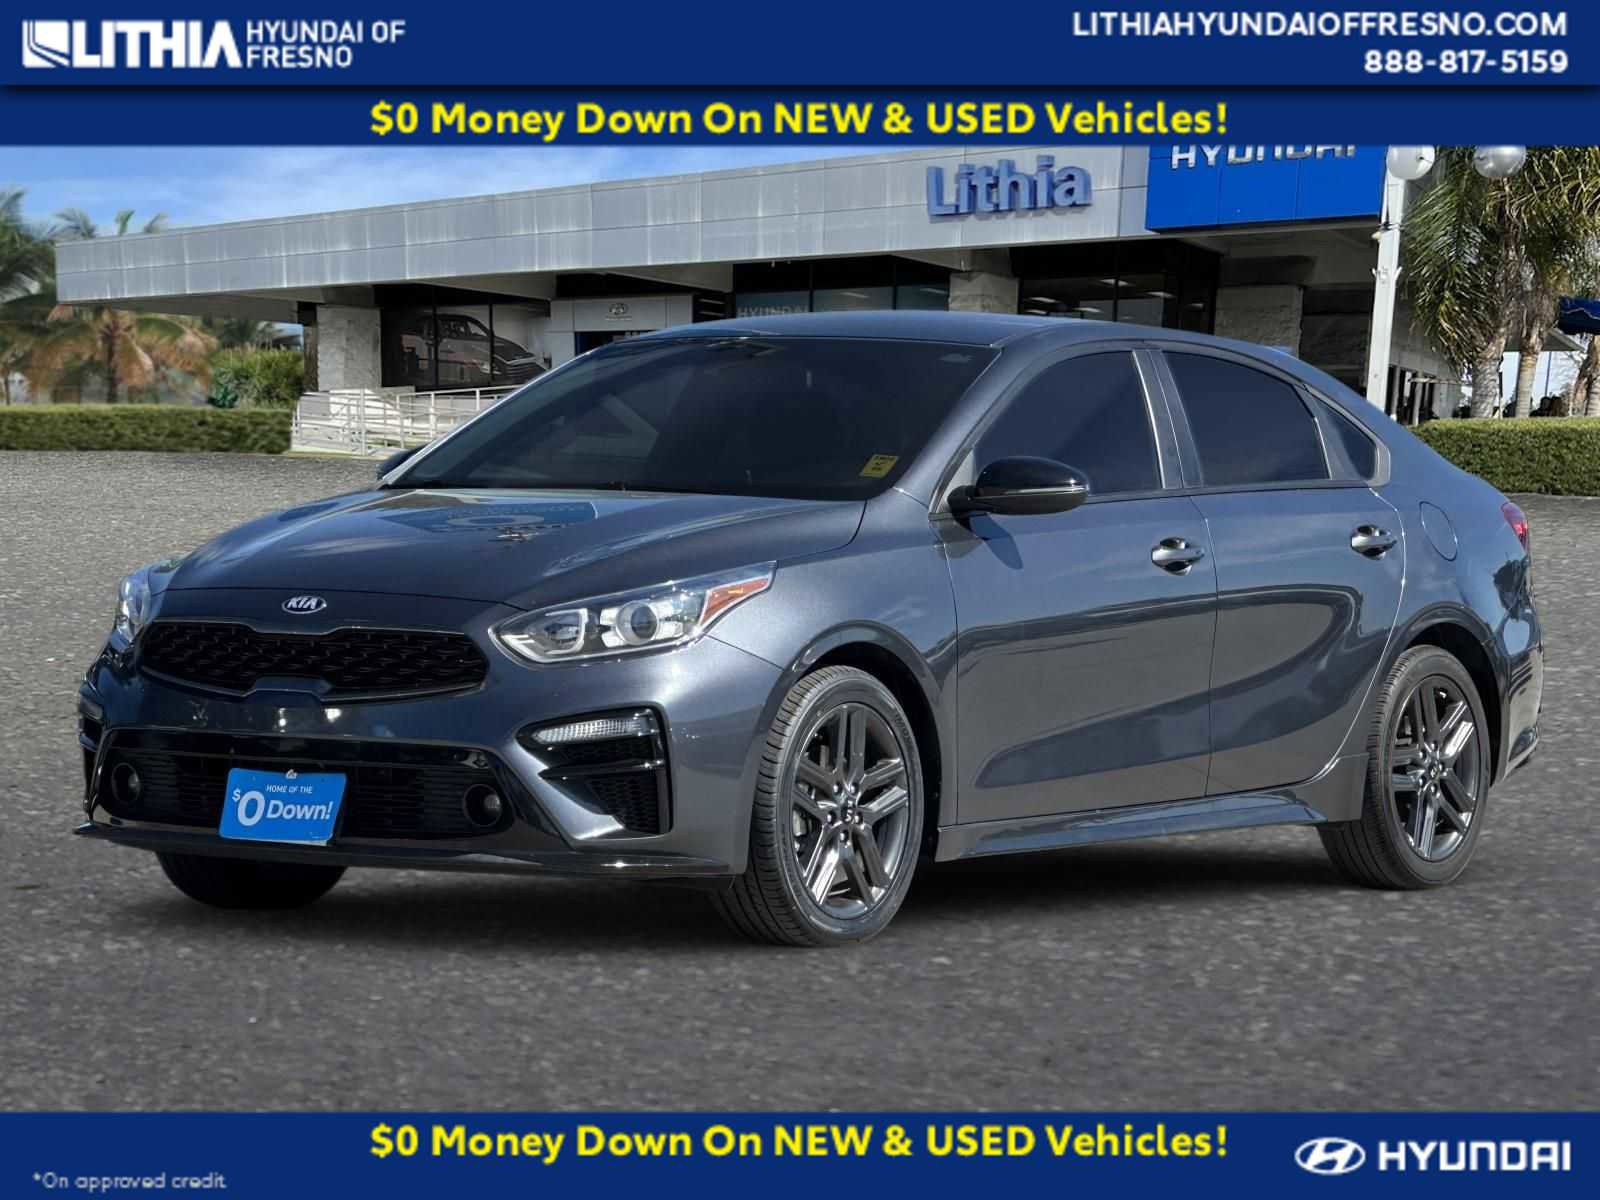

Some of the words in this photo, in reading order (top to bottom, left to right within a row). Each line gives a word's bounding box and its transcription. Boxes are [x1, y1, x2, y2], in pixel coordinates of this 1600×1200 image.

[926, 154, 1092, 216] Lithia
[286, 596, 319, 610] KIA
[265, 784, 288, 794] HOME
[288, 785, 299, 794] OF
[299, 784, 313, 794] THE
[232, 787, 266, 826] $0
[266, 799, 334, 821] Down!
